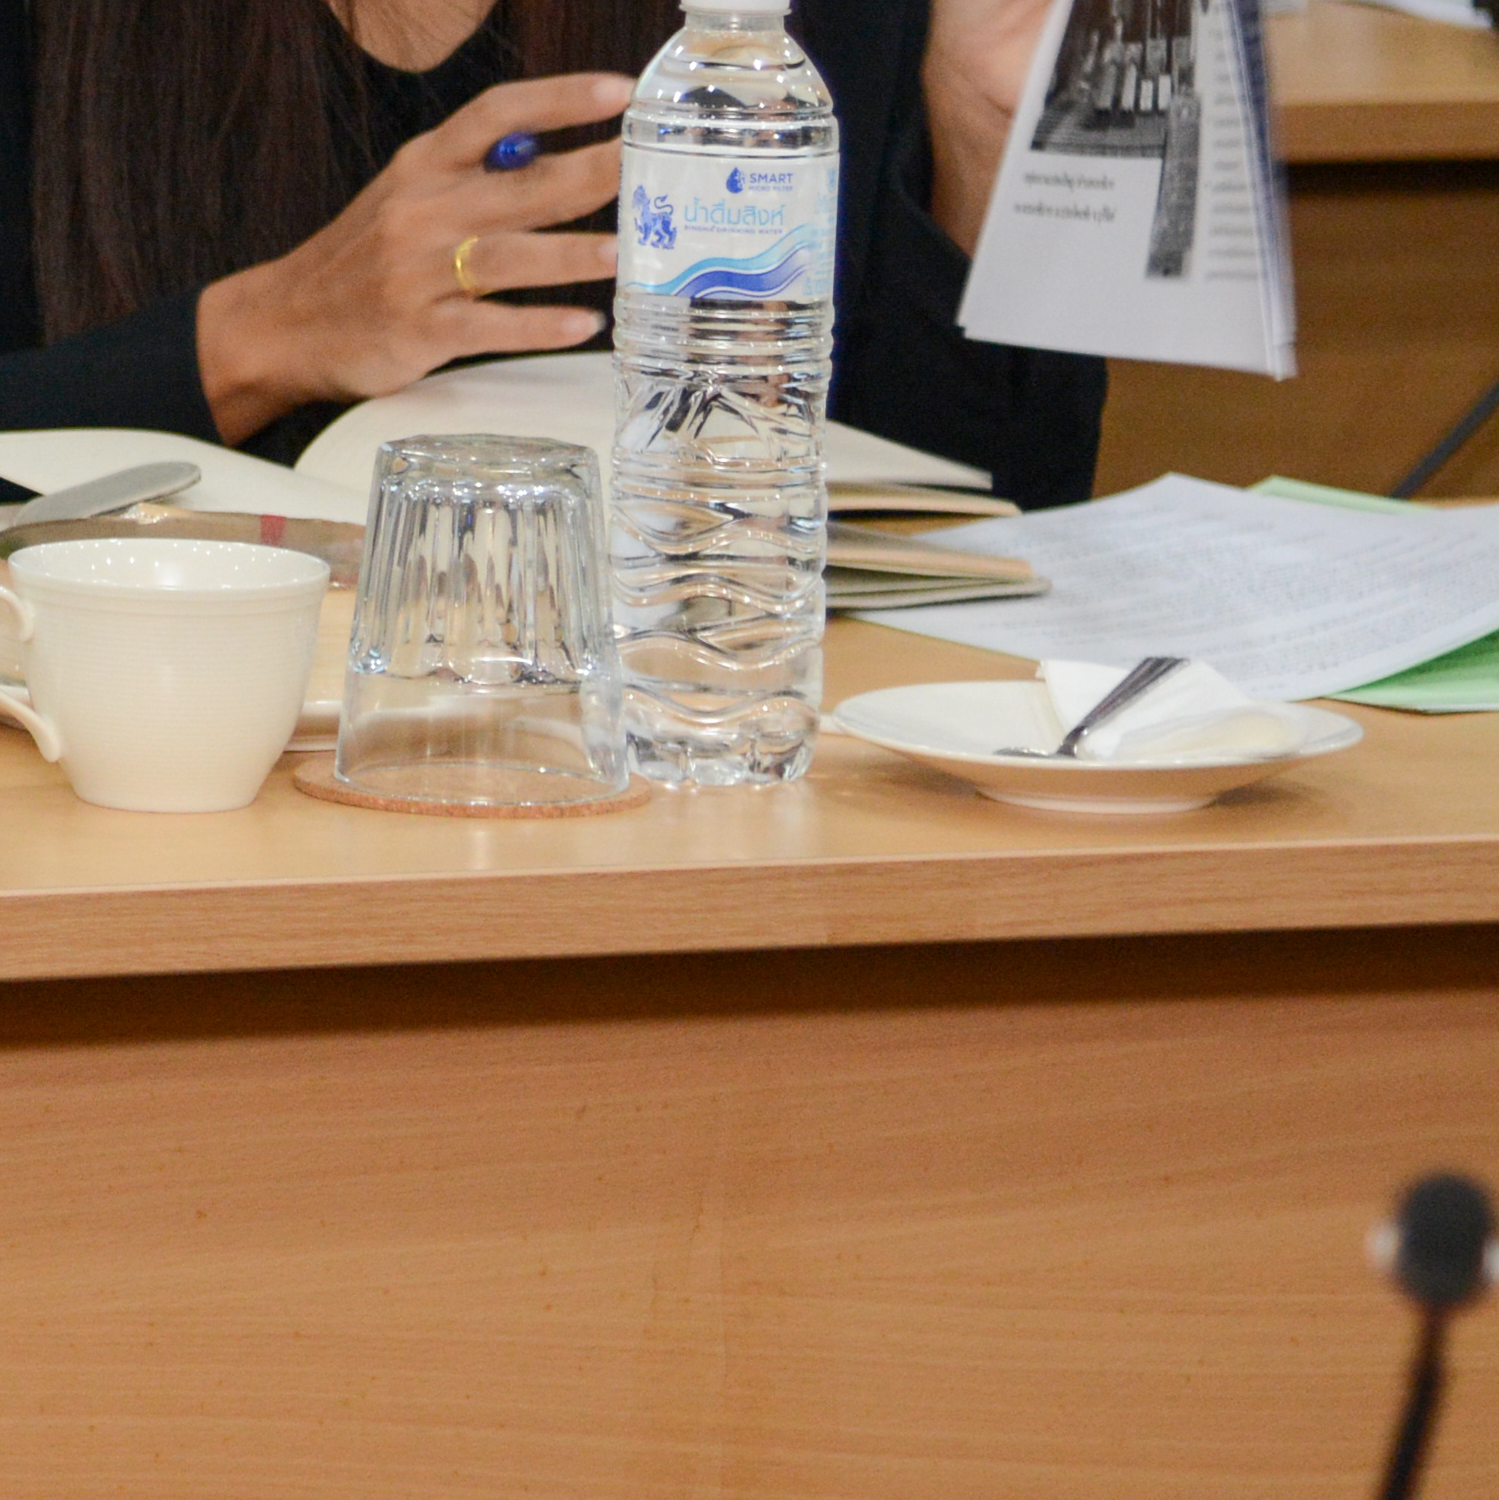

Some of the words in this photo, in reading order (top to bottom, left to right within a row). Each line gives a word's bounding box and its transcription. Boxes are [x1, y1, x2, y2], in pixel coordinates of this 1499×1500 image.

[749, 172, 794, 185] SMART
[684, 196, 786, 226] น้ำดื่มสิงห์
